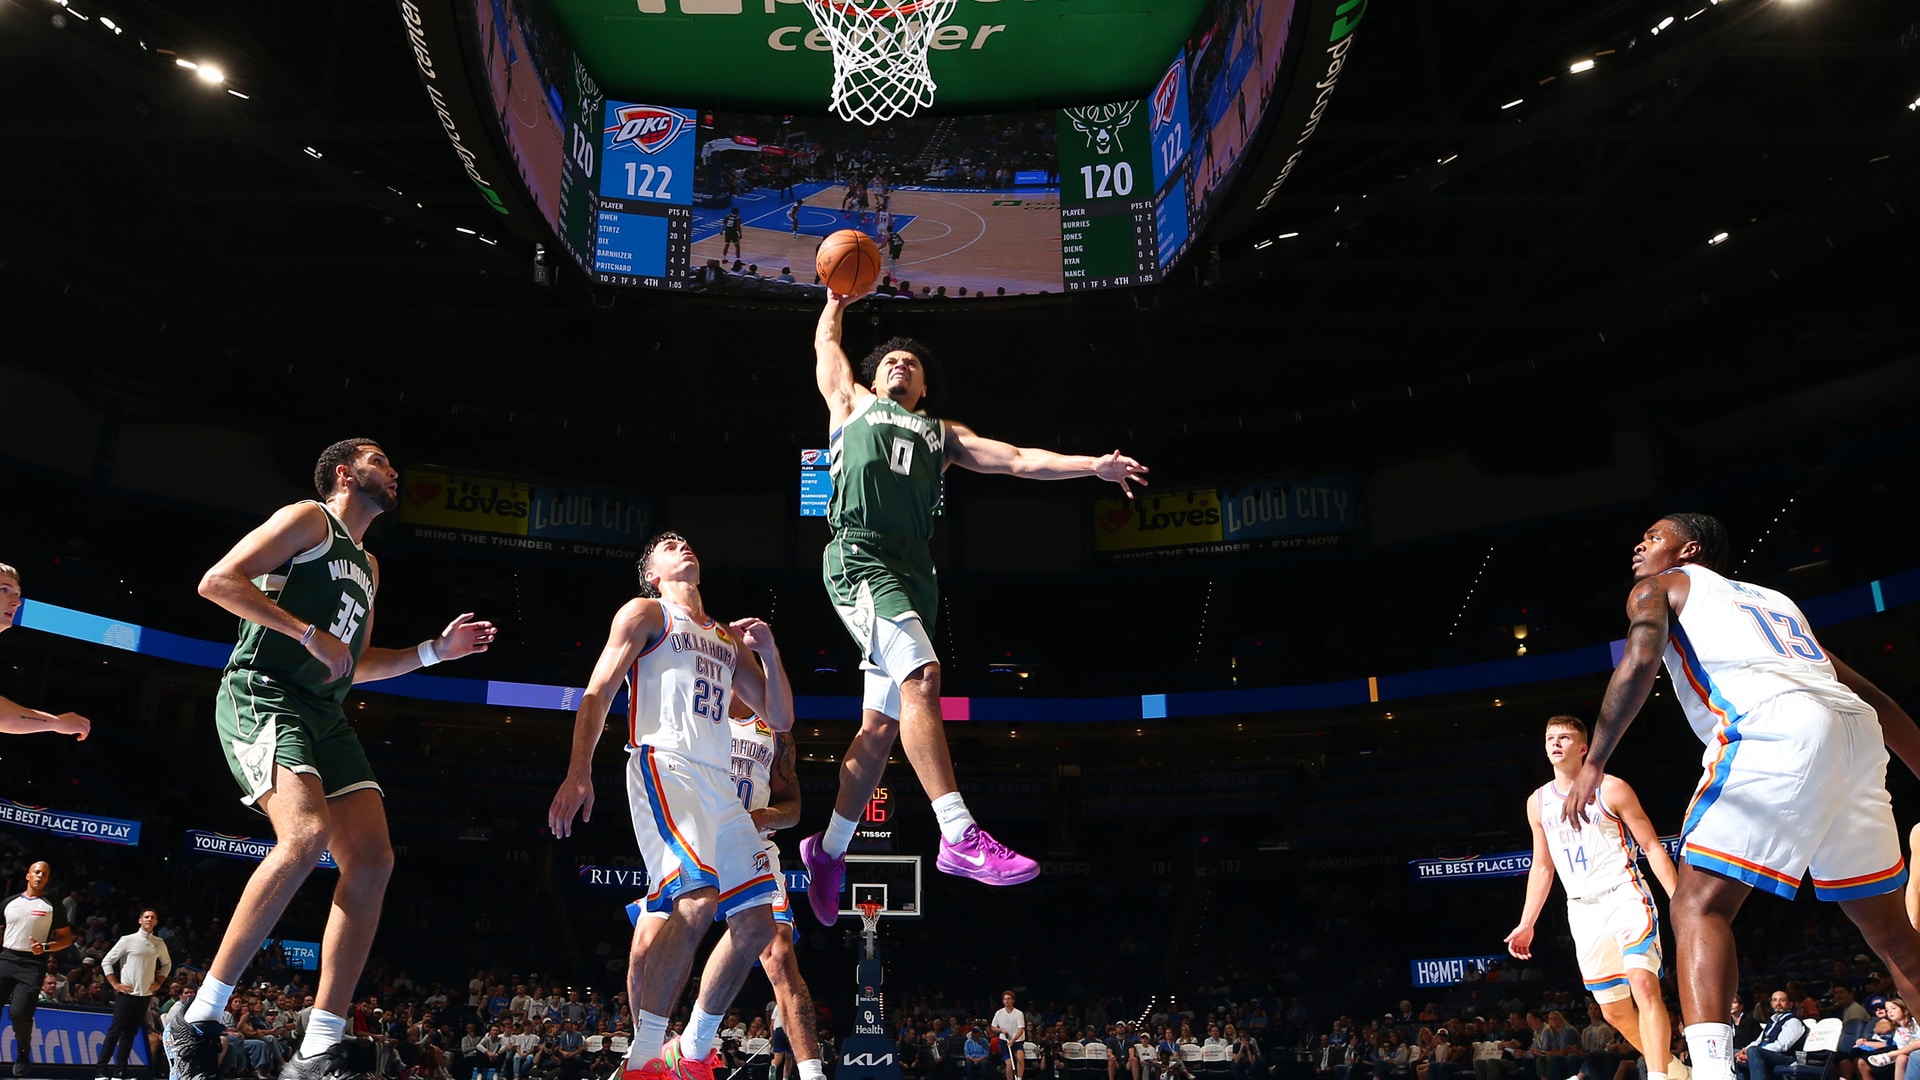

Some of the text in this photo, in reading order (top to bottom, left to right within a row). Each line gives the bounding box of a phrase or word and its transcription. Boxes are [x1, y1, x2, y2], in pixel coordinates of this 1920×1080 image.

[767, 19, 1006, 51] center
[1297, 33, 1353, 145] paycom
[427, 84, 490, 186] paycom
[616, 116, 670, 142] OKC
[572, 122, 594, 178] 120
[1161, 122, 1183, 177] 122
[624, 162, 672, 200] 122
[1080, 162, 1133, 199] 120
[600, 201, 624, 210] PLAYER
[600, 214, 618, 222] OWEH
[1062, 209, 1085, 217] PLAYER
[599, 225, 620, 234] STIRTZ
[1063, 221, 1090, 229] BURRIES
[596, 262, 631, 272] PRITCHARD
[597, 250, 632, 260] BARNHIZER
[644, 278, 658, 287] 4TH
[1114, 277, 1129, 285] 4TH
[864, 410, 940, 453] MILWAUKEE
[890, 436, 914, 476] 0
[444, 486, 527, 518] Loves
[1227, 487, 1348, 534] LOUD CITY
[1137, 505, 1220, 530] Loves
[415, 528, 635, 559] BRING THE THUNDER EXIT NOW
[1187, 543, 1250, 555] THUNDER
[1272, 538, 1303, 549] EXIT
[1307, 536, 1339, 546] NOW
[329, 591, 366, 645] 35
[1734, 602, 1828, 663] 13
[696, 655, 722, 682] CITY
[693, 677, 724, 724] 23
[15, 810, 40, 824] BEST
[42, 815, 79, 831] PLACE
[82, 821, 97, 833] TO
[100, 824, 131, 838] PLAY
[865, 800, 885, 822] 16
[195, 837, 226, 851] YOUR
[1152, 862, 1172, 874] 101
[1220, 860, 1241, 872] 102
[1419, 857, 1532, 876] THE BEST PLACE TO
[1564, 846, 1588, 873] 14
[856, 1024, 884, 1034] Health
